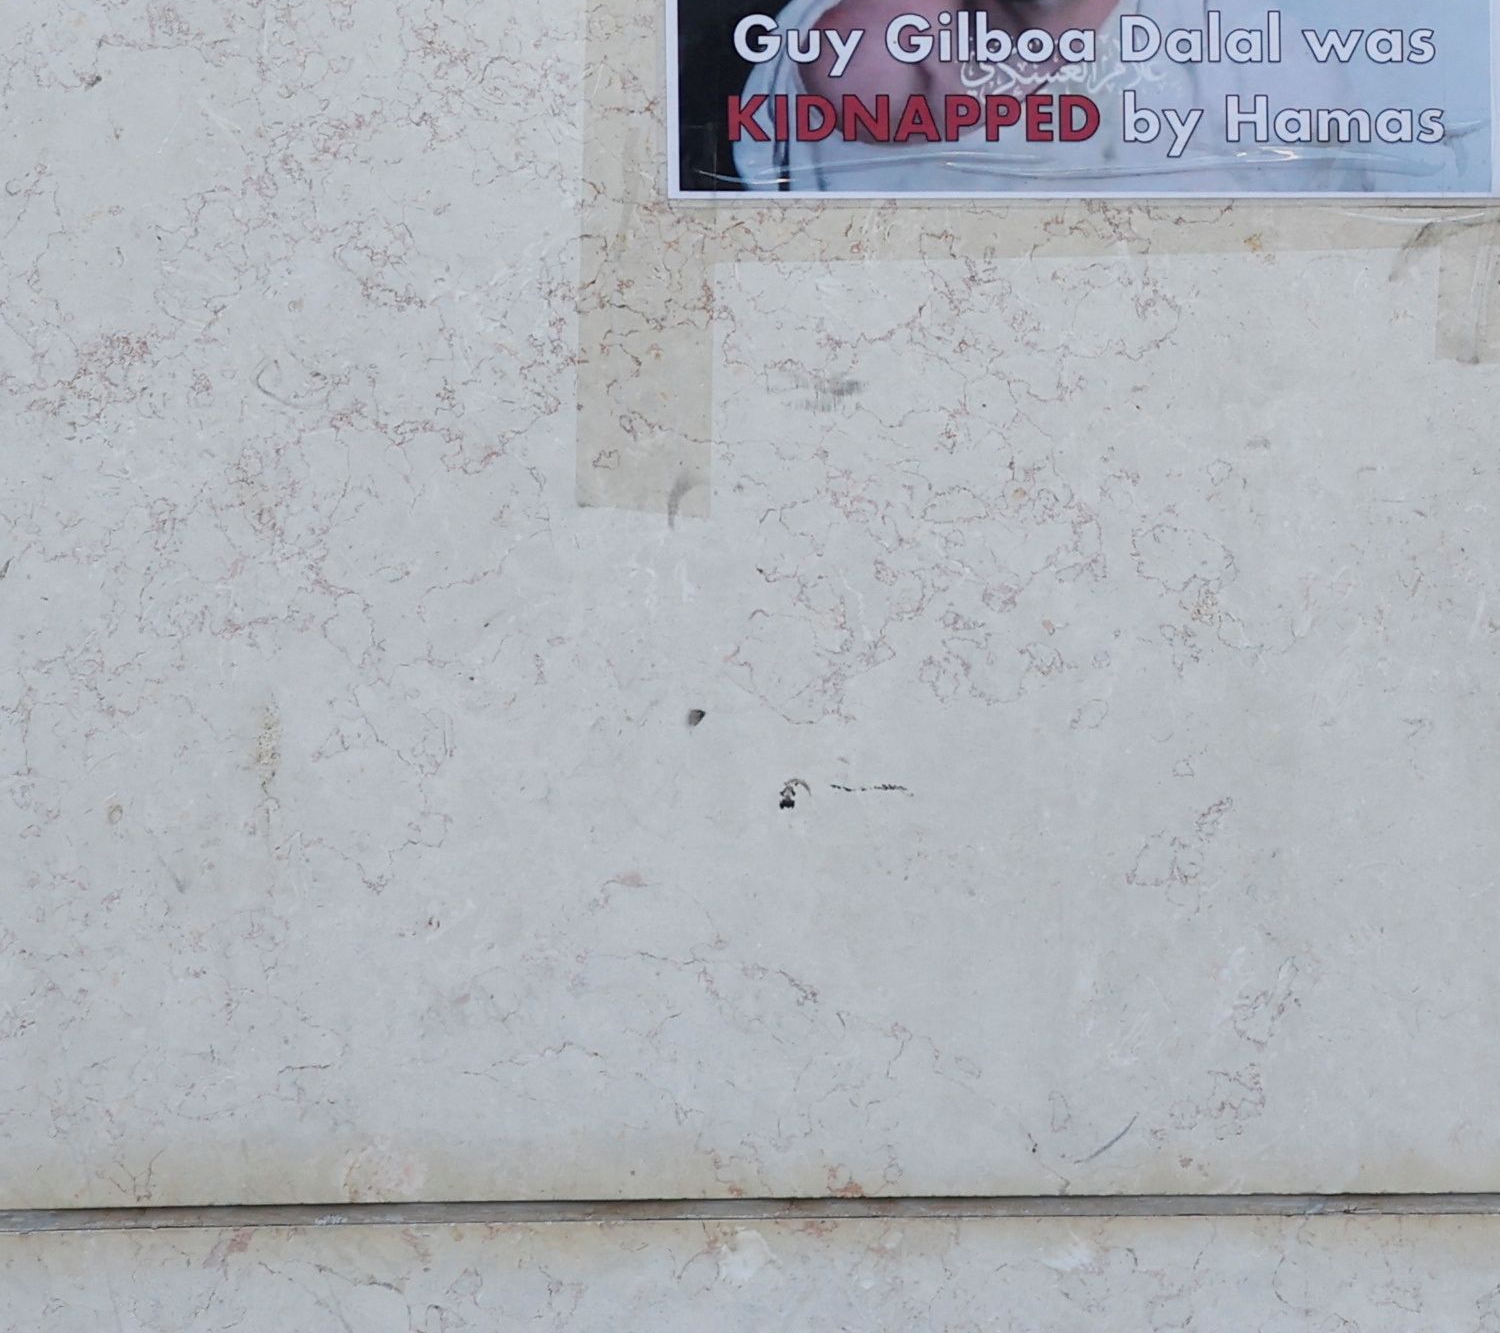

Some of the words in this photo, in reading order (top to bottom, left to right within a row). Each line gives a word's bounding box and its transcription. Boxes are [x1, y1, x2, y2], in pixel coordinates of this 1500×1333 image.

[732, 12, 865, 78] Guy
[884, 11, 1097, 64] Gilboa
[1119, 10, 1281, 64] Dalal
[1303, 25, 1436, 64] was
[726, 94, 1101, 143] KIDNAPPED
[1123, 90, 1204, 158] by
[1225, 94, 1445, 144] Hamas
